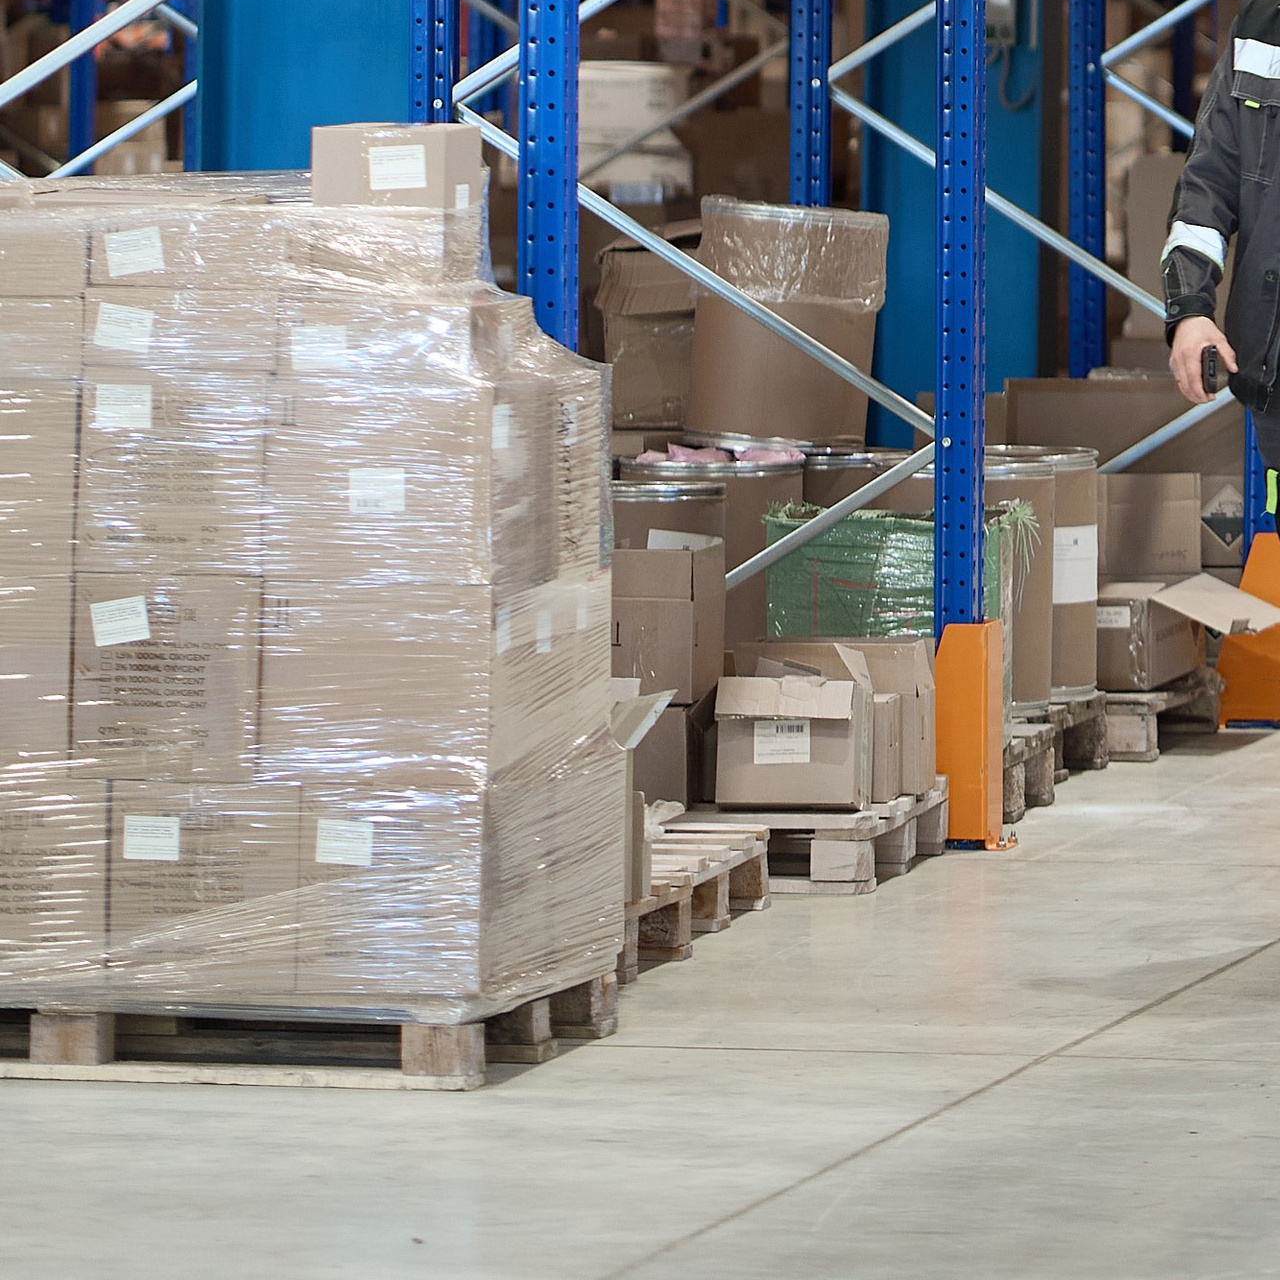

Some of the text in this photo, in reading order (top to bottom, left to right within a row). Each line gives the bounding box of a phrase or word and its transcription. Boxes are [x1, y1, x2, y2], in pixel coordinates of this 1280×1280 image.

[136, 651, 168, 661] 1000ML
[169, 653, 210, 662] OXYGENT
[129, 663, 162, 672] 1000ML
[164, 665, 205, 674] OXYGENT
[12, 883, 54, 891] OXYGENT
